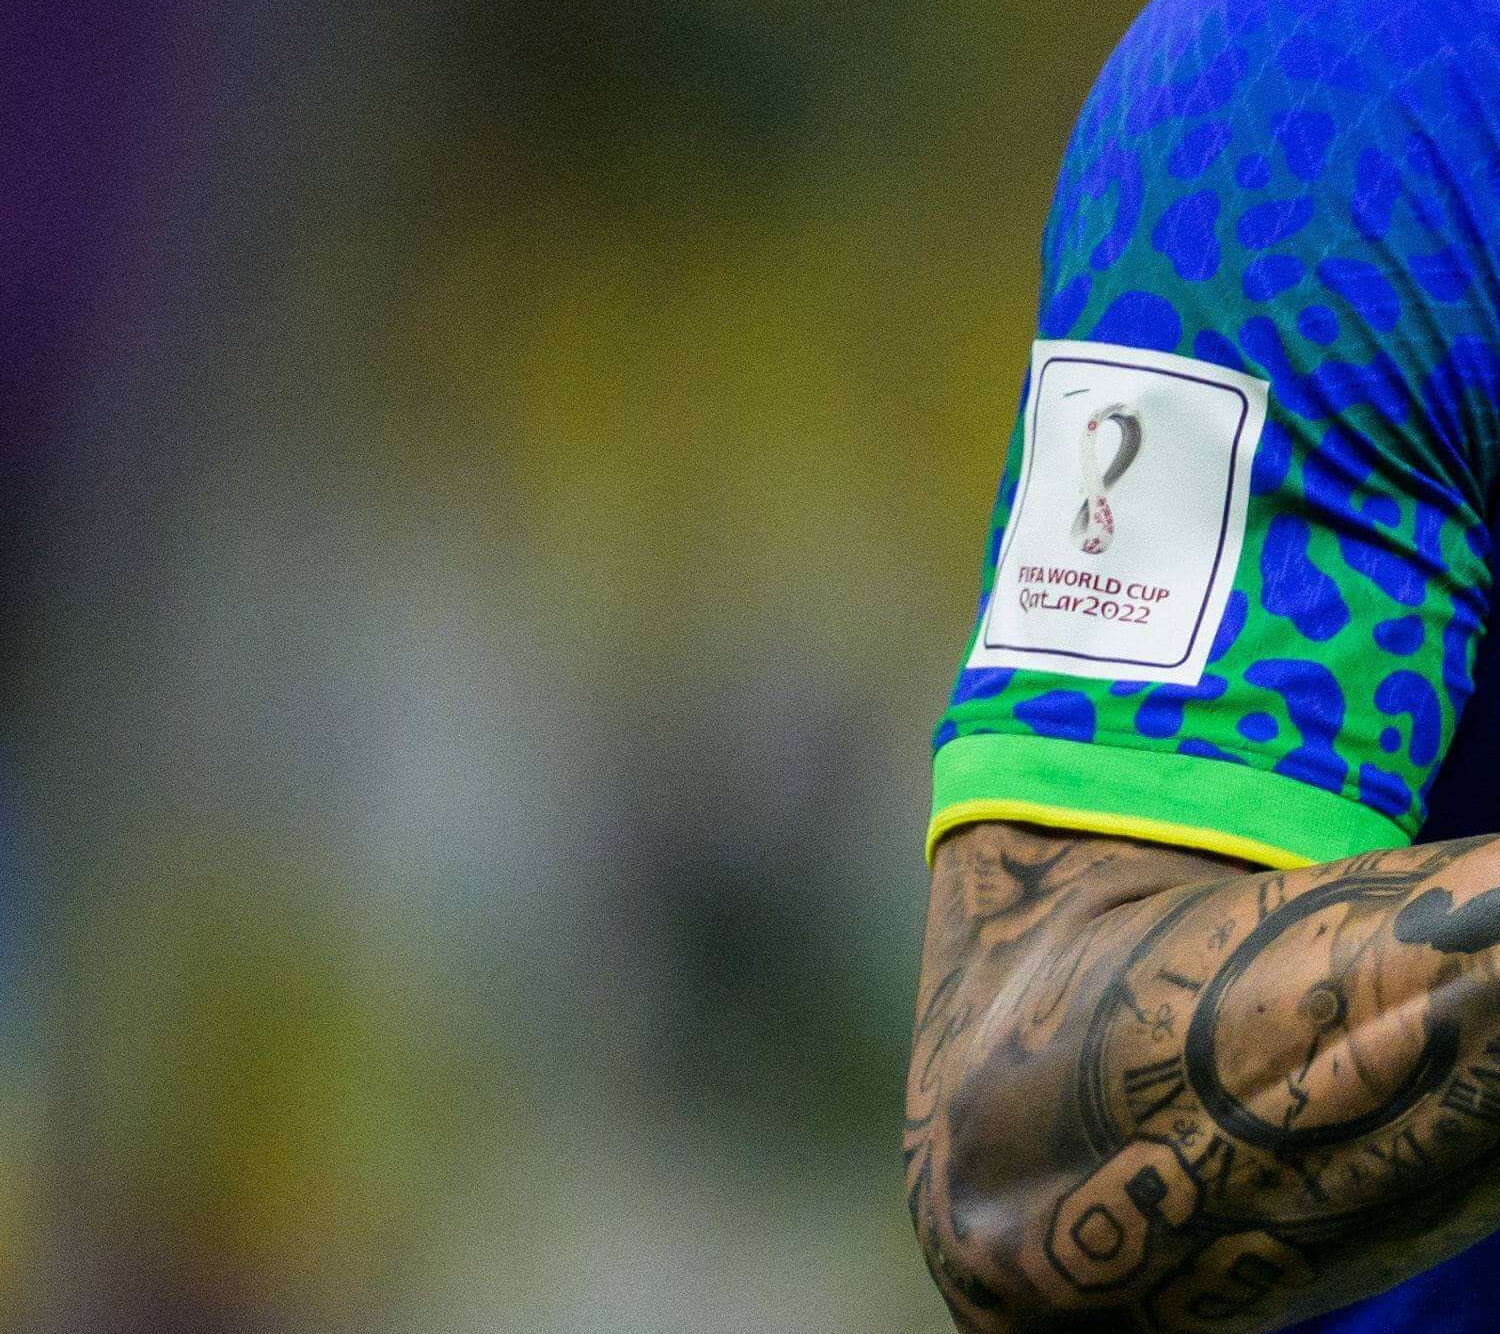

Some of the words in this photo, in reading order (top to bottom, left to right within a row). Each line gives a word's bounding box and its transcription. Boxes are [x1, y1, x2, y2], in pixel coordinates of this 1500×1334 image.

[1018, 566, 1044, 584] FIFA
[1048, 567, 1122, 596] WORLD
[1126, 583, 1170, 603] CUP
